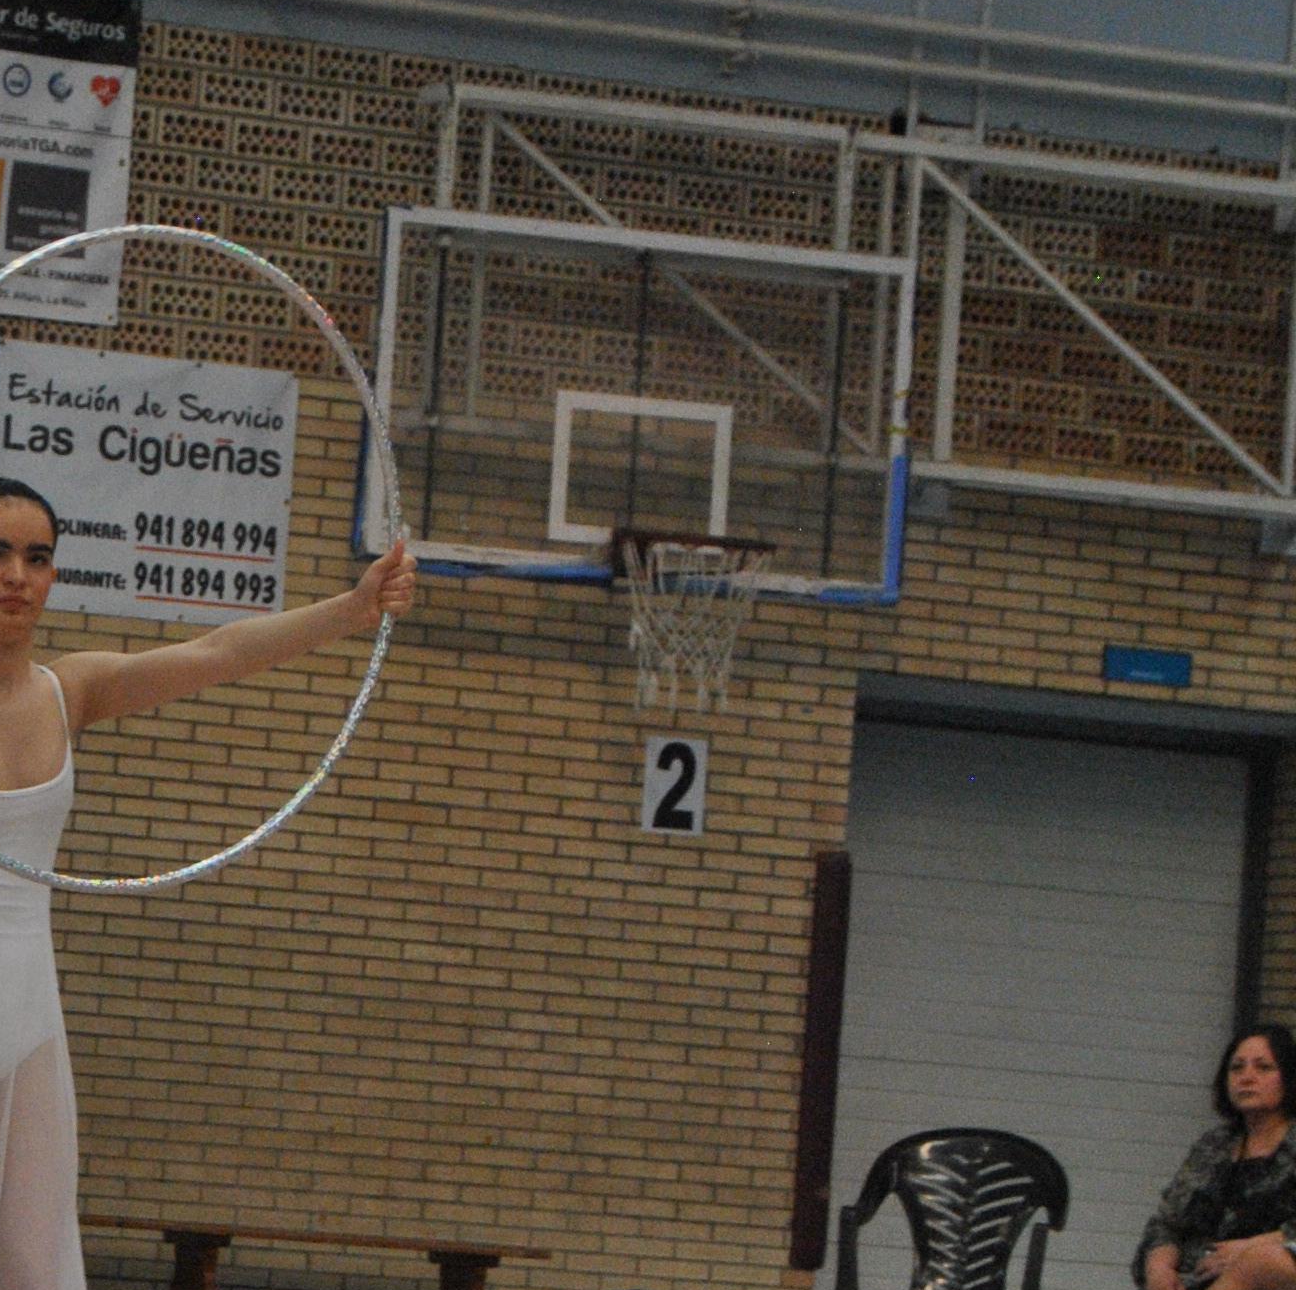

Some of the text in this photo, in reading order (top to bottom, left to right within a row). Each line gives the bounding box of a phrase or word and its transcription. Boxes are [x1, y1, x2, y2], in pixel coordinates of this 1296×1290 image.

[13, 7, 38, 29] de
[46, 12, 126, 42] Seguros
[8, 372, 121, 414] Estación
[134, 392, 168, 419] de
[178, 392, 285, 432] Servicio
[3, 413, 282, 478] Las Cigüeñas
[134, 511, 175, 546] 941
[181, 517, 226, 551] 894
[233, 521, 279, 556] 994
[133, 560, 175, 595] 941
[180, 567, 226, 600] 894
[233, 570, 278, 605] 993
[652, 741, 696, 830] 2
